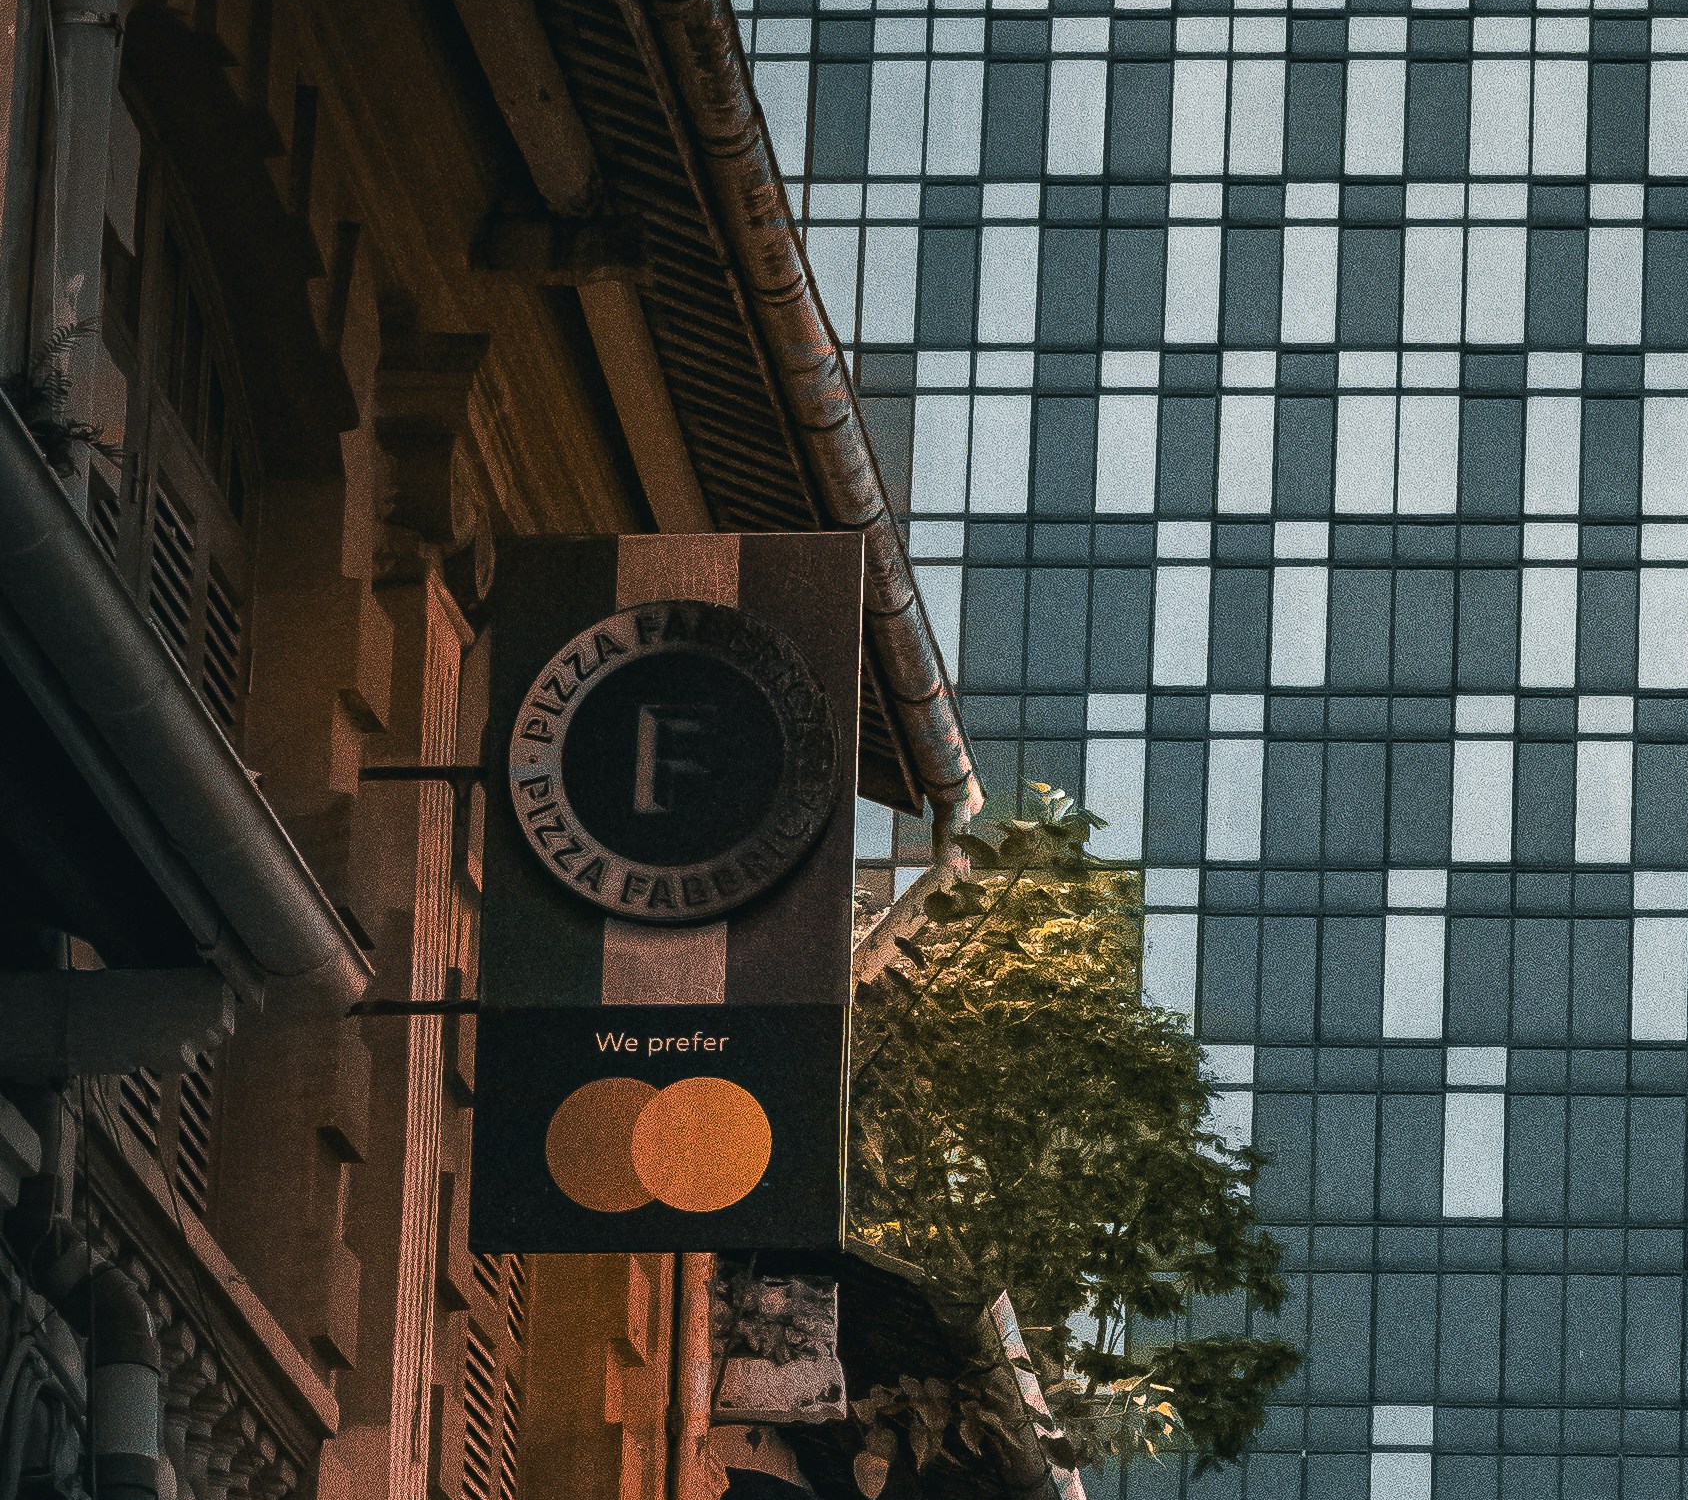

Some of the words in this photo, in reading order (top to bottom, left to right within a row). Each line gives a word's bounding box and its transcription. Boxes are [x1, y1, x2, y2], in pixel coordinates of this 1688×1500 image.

[521, 631, 628, 744] PIZZA
[632, 704, 718, 815] F
[518, 774, 611, 894] PIZZA
[595, 1032, 639, 1052] We
[648, 1031, 730, 1057] prefer
